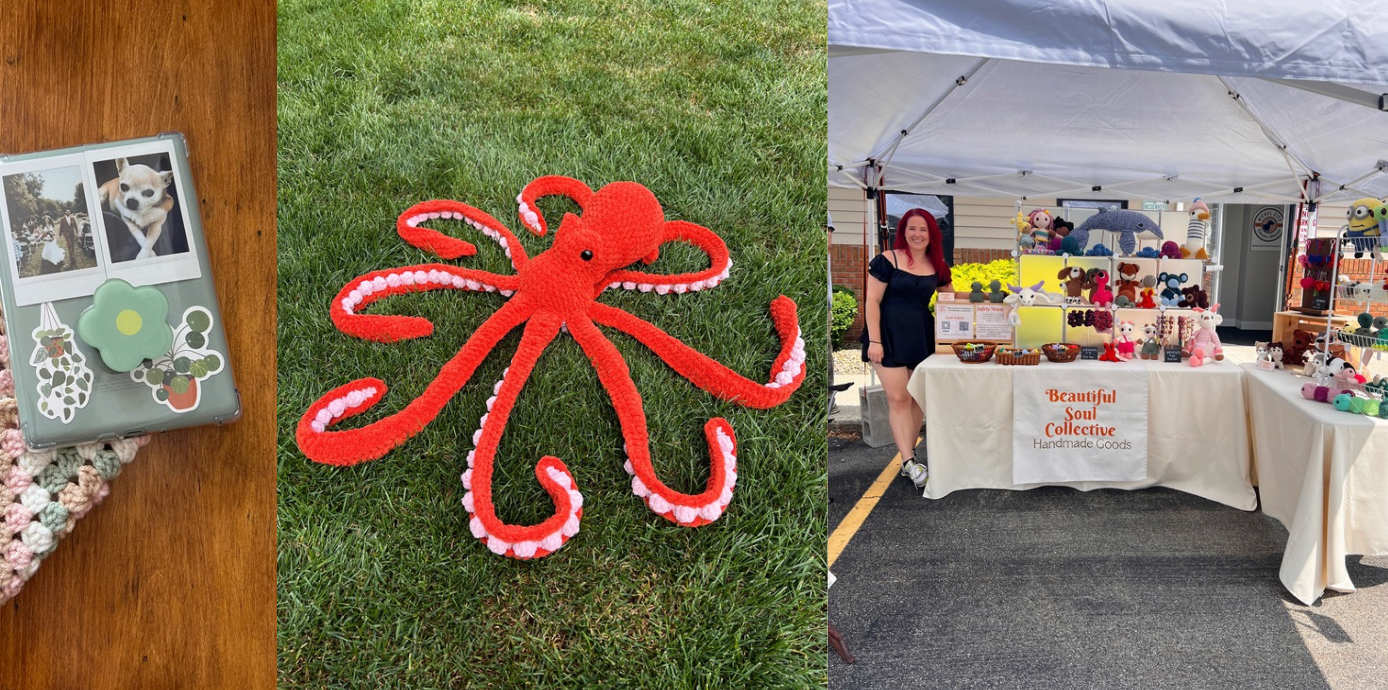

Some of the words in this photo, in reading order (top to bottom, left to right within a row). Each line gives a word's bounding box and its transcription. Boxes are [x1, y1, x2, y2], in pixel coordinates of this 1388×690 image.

[1273, 211, 1282, 221] CITY
[1045, 388, 1116, 406] Beautiful
[1064, 406, 1097, 422] Soul
[1045, 421, 1116, 438] Collective
[1033, 438, 1094, 449] Handmade
[1096, 438, 1132, 450] Goods
